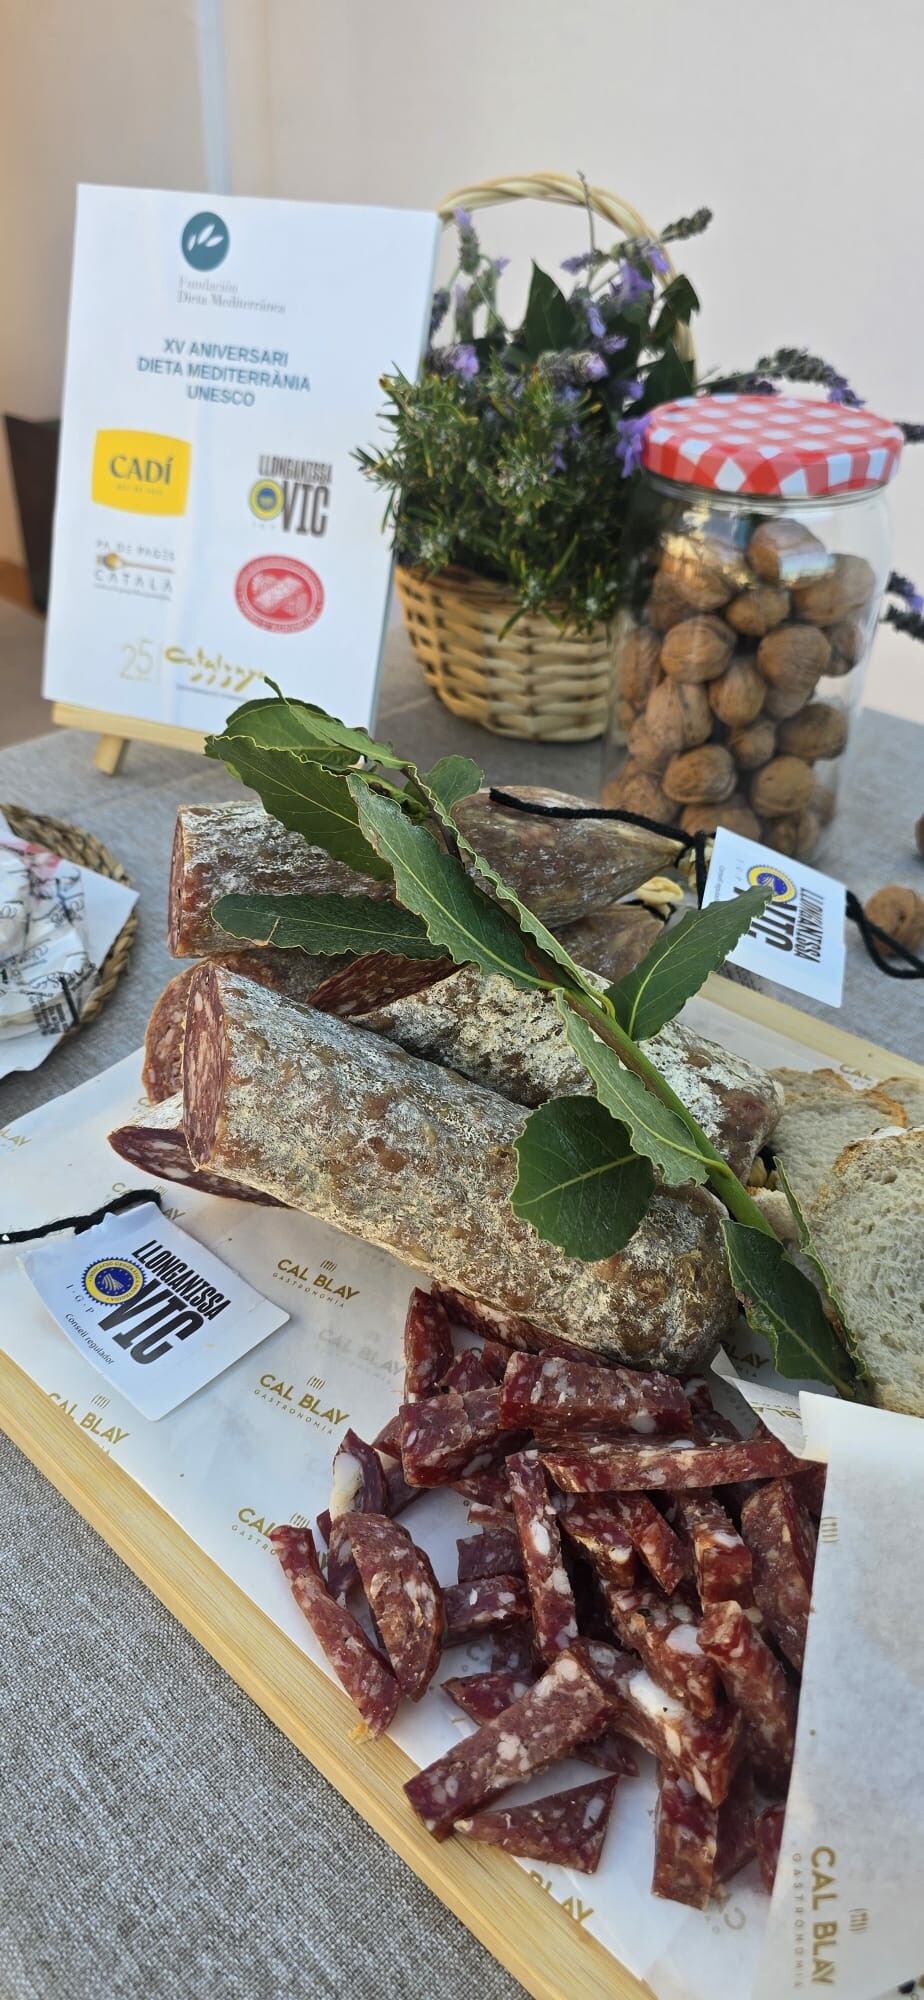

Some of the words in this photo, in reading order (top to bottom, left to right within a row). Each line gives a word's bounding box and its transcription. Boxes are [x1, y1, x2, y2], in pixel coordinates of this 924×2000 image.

[137, 356, 184, 376] DIETA
[187, 361, 311, 392] MEDITERRÀNIA
[164, 338, 185, 354] XV
[190, 341, 289, 368] ANIVERSARI
[187, 384, 256, 407] UNESCO
[109, 455, 175, 485] CADÍ
[282, 479, 330, 537] VIC
[132, 1239, 232, 1321] LLONGANISSA
[272, 1272, 345, 1308] GASTRONOMIA
[278, 1259, 309, 1281] CAL
[313, 1274, 361, 1300] BLAY
[65, 1313, 88, 1338] Consell
[84, 1336, 116, 1365] regulador
[97, 1278, 204, 1365] VIC
[254, 1388, 333, 1435] GASTRONOMIA
[260, 1374, 294, 1401] CAL
[298, 1393, 350, 1425] BLAY
[80, 1411, 131, 1444] BLAY
[810, 1845, 838, 1911] CAL
[811, 1920, 838, 1984] BLAY
